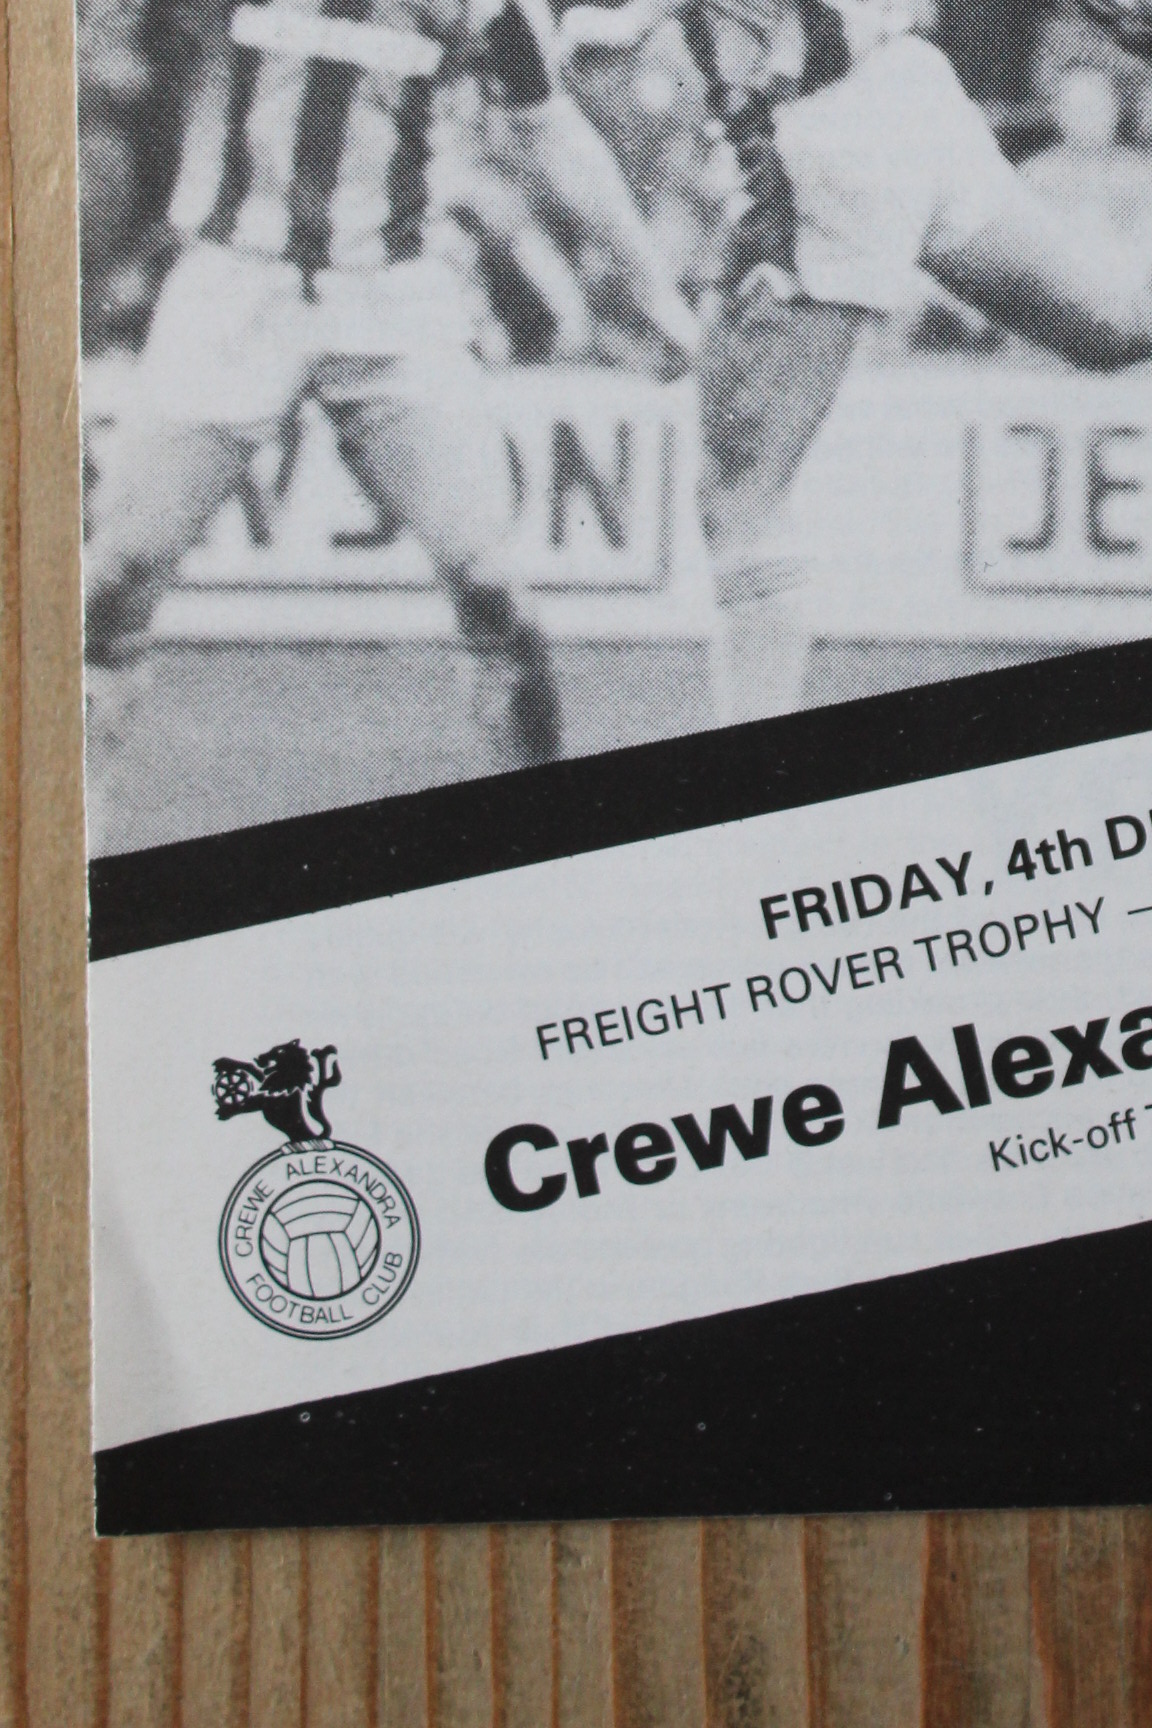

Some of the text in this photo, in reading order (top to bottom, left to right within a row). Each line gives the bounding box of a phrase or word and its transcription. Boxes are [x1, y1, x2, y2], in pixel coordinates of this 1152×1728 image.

[760, 851, 994, 940] FRIDAY,
[1007, 829, 1093, 881] 4th
[536, 983, 731, 1061] FREIGHT
[747, 946, 904, 1012] ROVER
[913, 897, 1104, 972] TROPHY
[485, 1083, 845, 1212] Crewe
[989, 1108, 1136, 1172] Kick-off
[234, 1155, 401, 1257] CREWE ALEXANDRA
[246, 1251, 403, 1323] FOOTBALL CLUB
